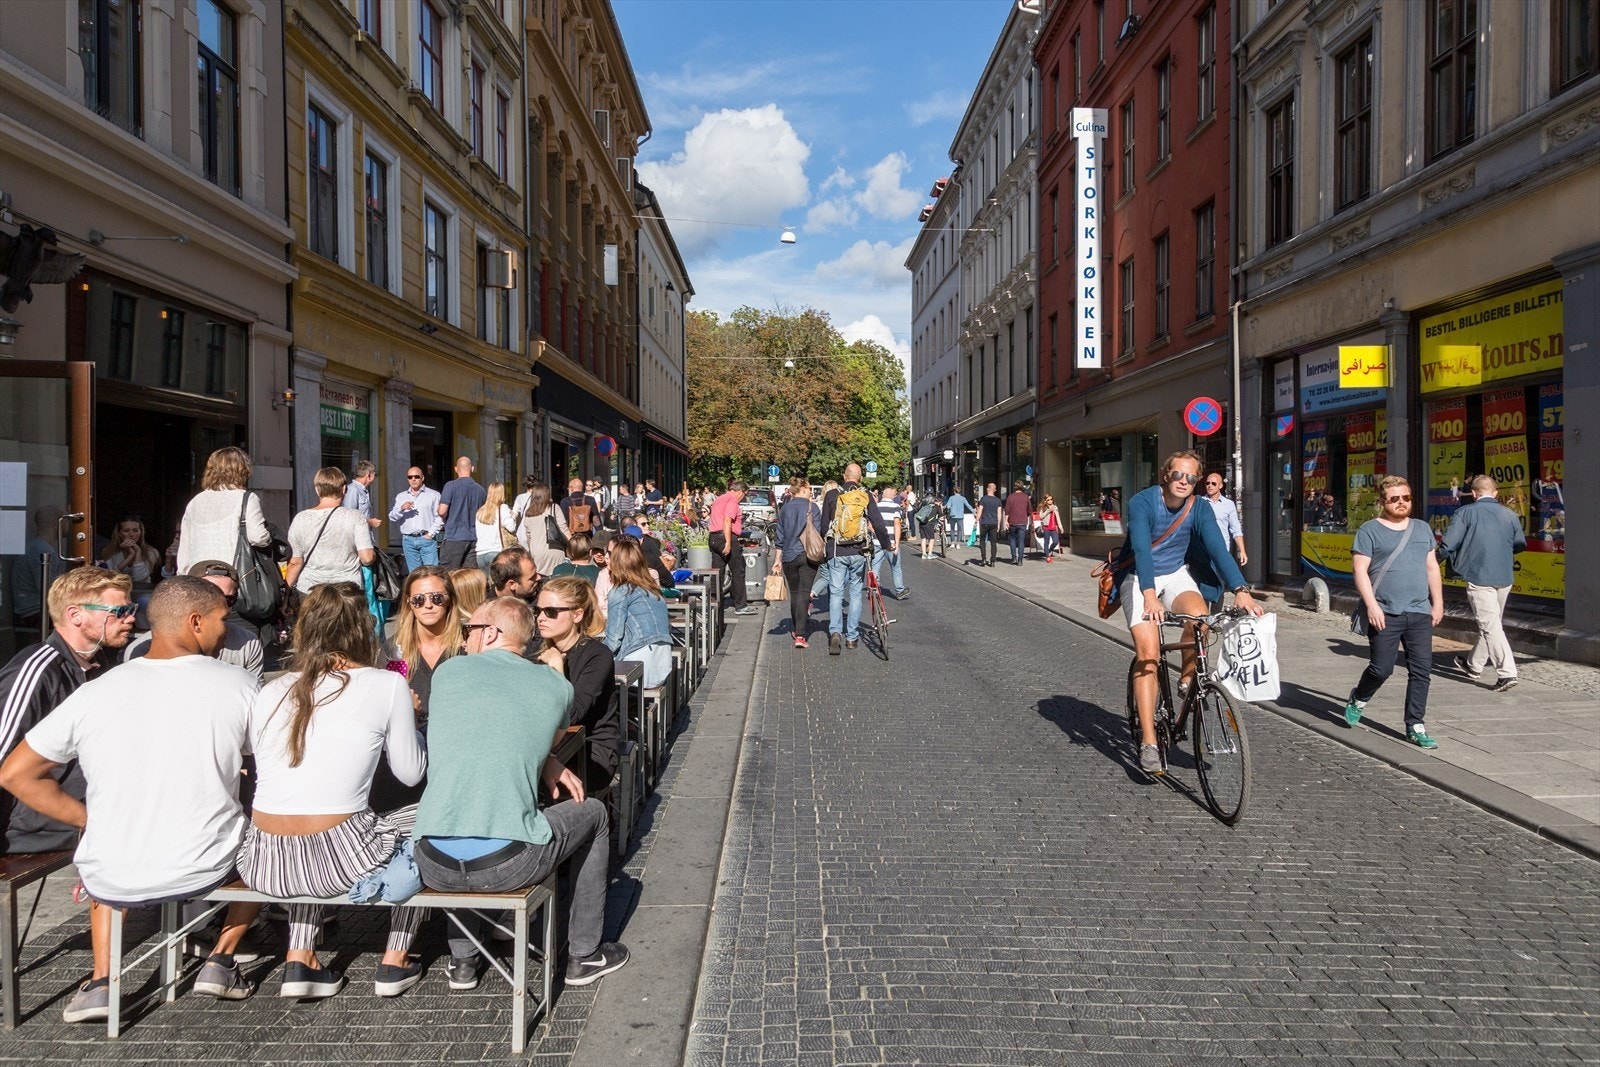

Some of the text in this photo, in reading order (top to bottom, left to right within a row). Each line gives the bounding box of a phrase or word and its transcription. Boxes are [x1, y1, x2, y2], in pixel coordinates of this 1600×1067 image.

[1076, 122, 1105, 133] Culina
[1083, 147, 1096, 359] STORKJØKKEN
[1425, 320, 1457, 339] BESTIL
[1458, 304, 1511, 330] BILLIGERE
[1502, 389, 1524, 401] YORK
[320, 407, 337, 427] BEST
[341, 412, 356, 431] TEST
[1431, 419, 1464, 440] 7900
[1485, 411, 1524, 434] 3900
[1500, 441, 1526, 455] ABABA
[1489, 464, 1525, 483] 4900
